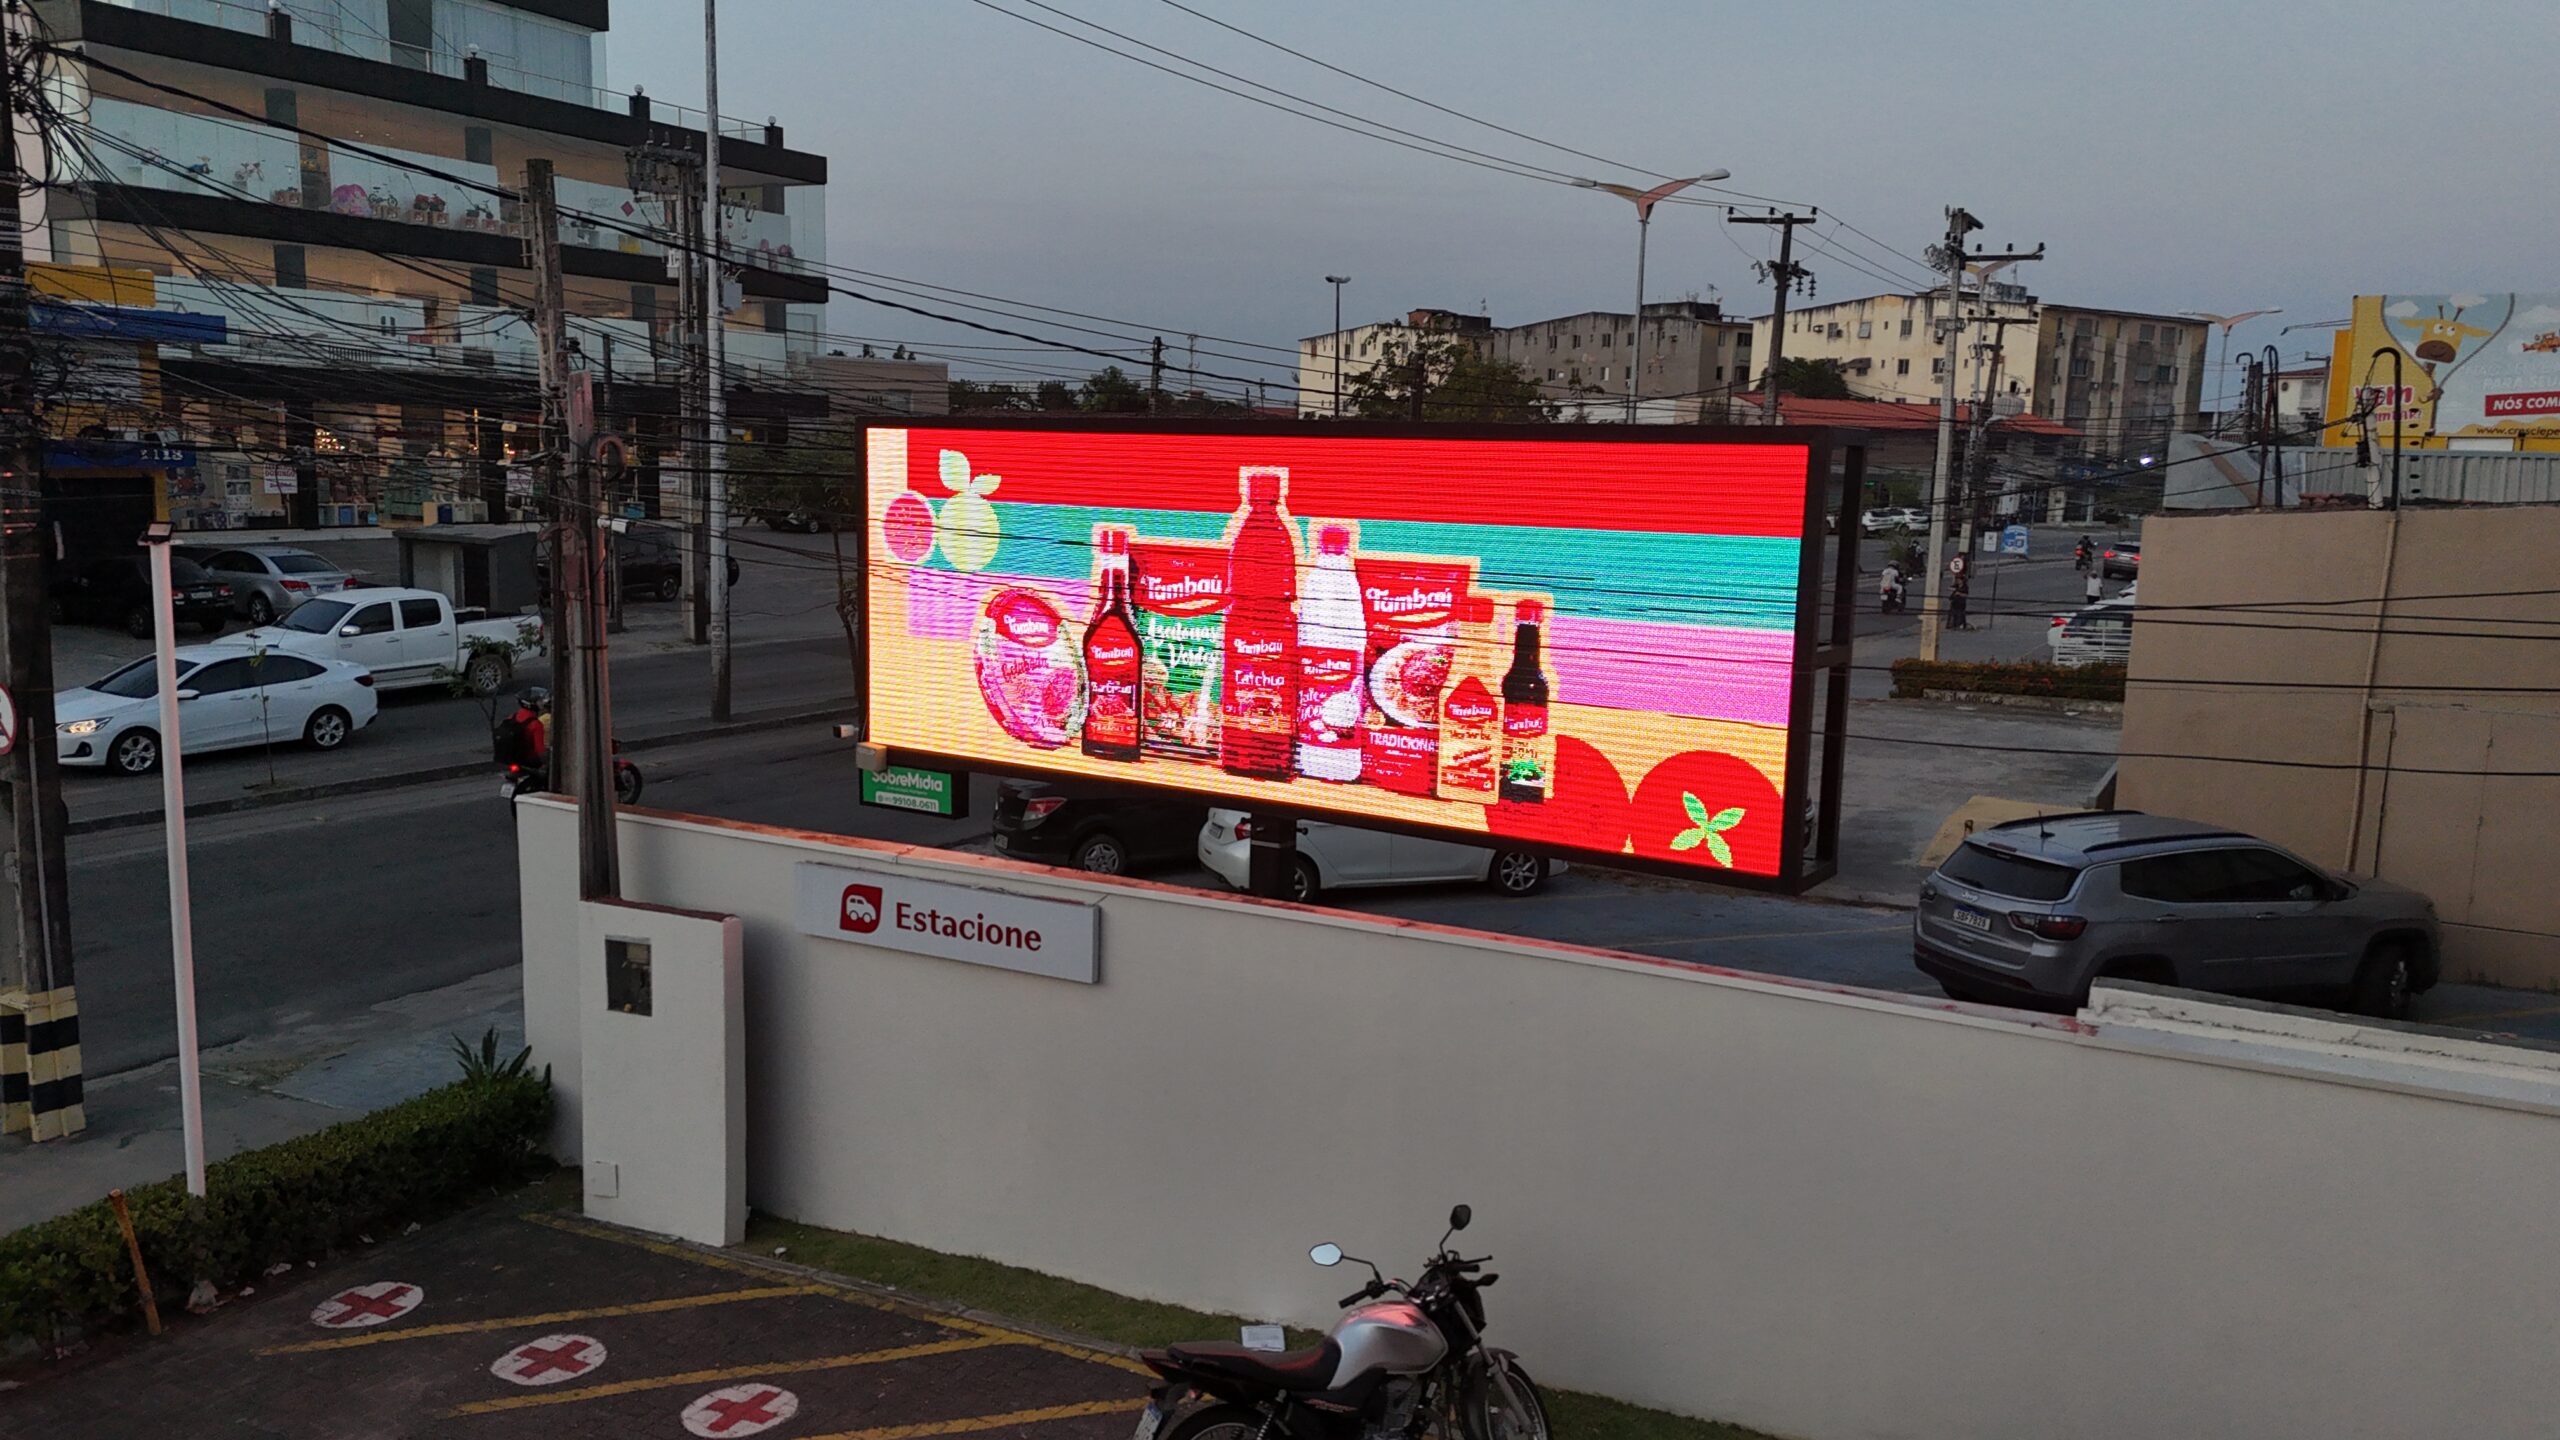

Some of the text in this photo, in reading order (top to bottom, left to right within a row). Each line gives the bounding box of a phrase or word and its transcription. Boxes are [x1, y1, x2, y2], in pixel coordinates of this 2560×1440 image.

[2493, 396, 2523, 411] NÓS
[1140, 574, 1222, 600] Tambaú
[1366, 587, 1453, 612] Tambaú
[1233, 638, 1283, 655] Tambaú
[896, 902, 1042, 952] Estacione
